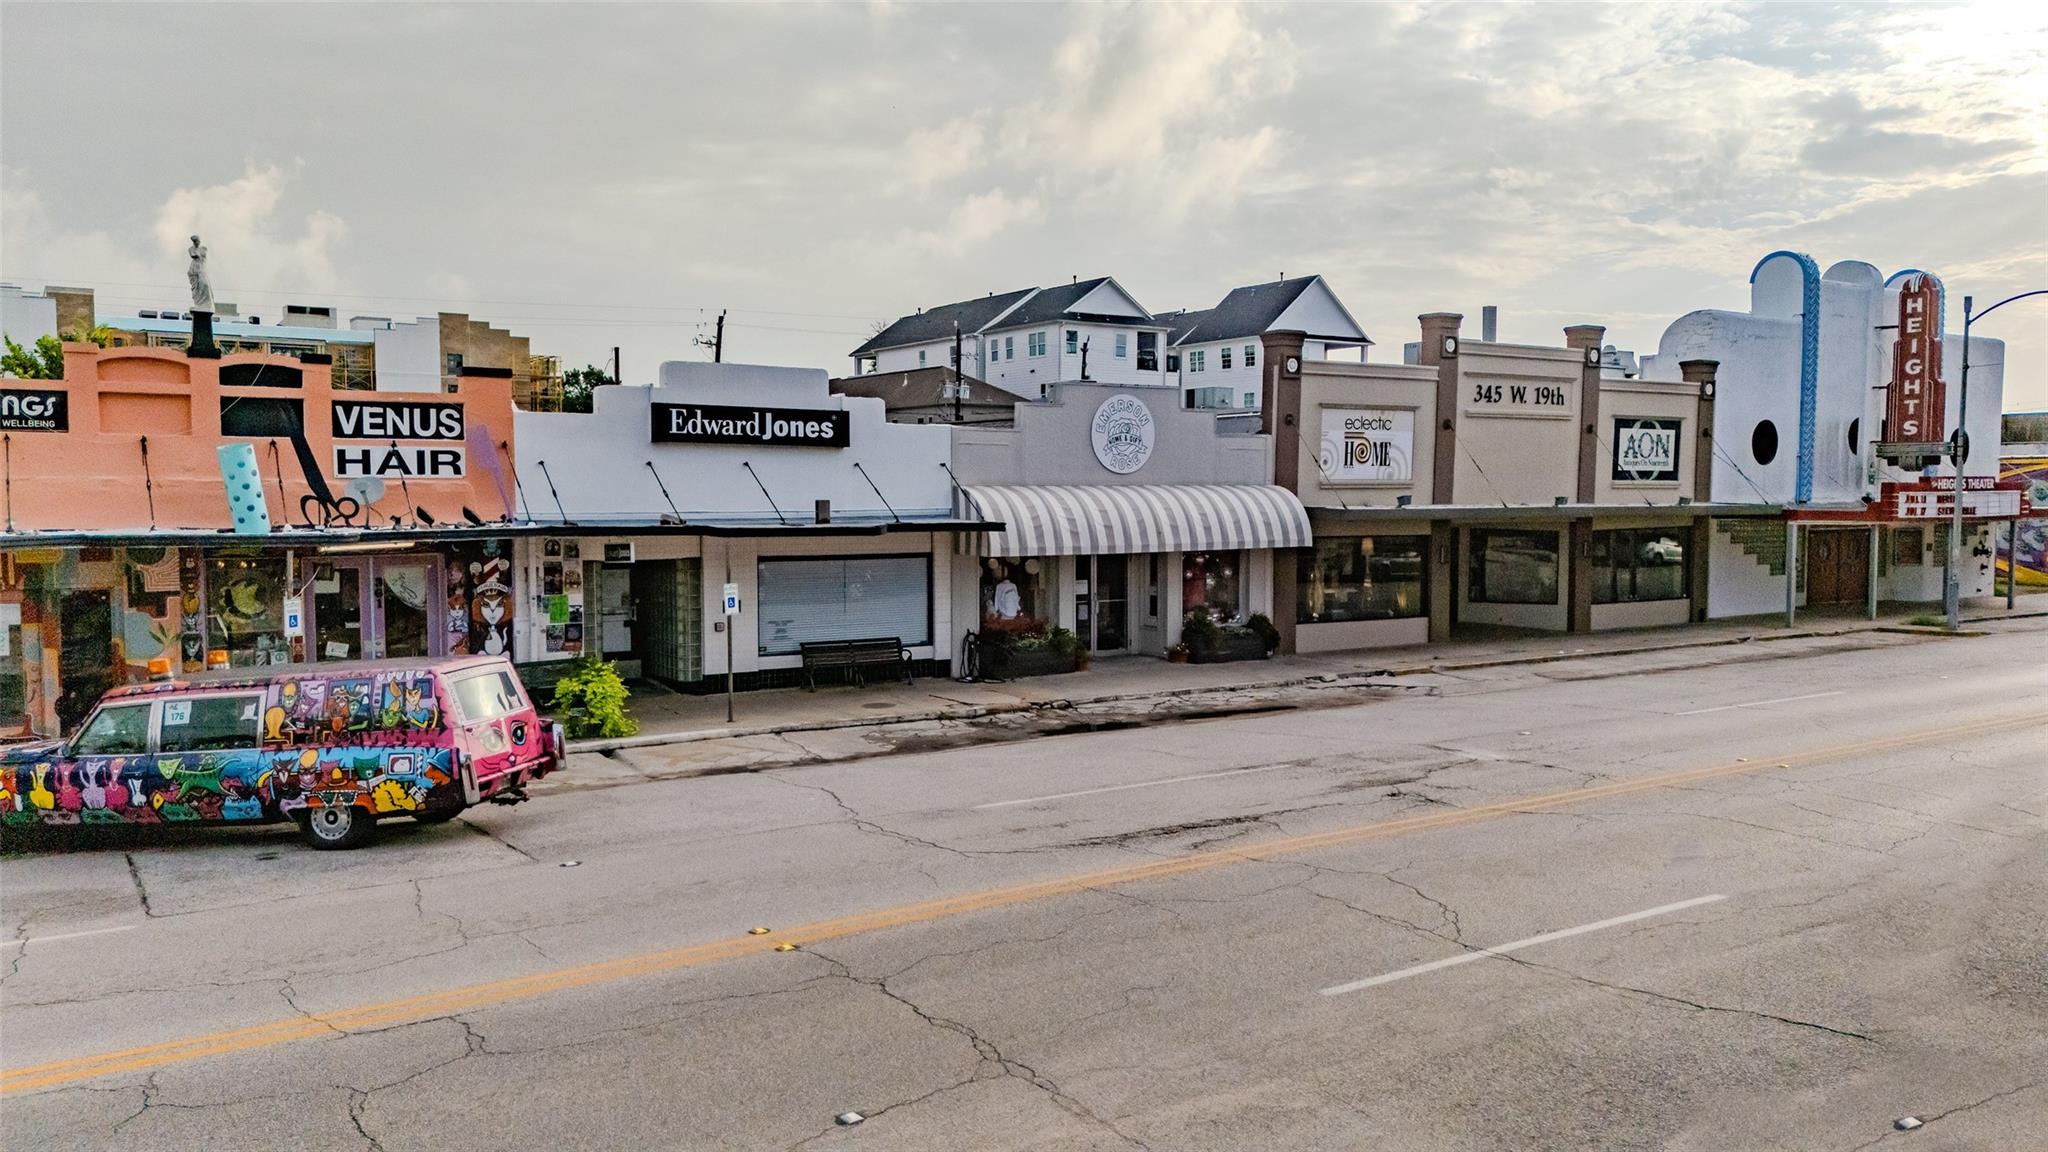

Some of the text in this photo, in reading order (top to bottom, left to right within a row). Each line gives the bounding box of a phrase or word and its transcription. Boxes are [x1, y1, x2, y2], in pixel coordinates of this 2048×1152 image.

[1902, 297, 1923, 436] HEIGHTS
[1473, 384, 1565, 406] 345 W. 19th
[1, 419, 56, 428] WELLBEING
[335, 405, 462, 438] VENUS
[668, 408, 835, 441] Edward Jones
[1096, 399, 1150, 434] EMERSON
[1344, 416, 1392, 431] eclectic
[1344, 436, 1392, 468] HOME
[1623, 431, 1670, 459] AON
[336, 448, 462, 476] HAIR
[1110, 454, 1141, 471] ROSE
[1968, 478, 1995, 490] THEATER
